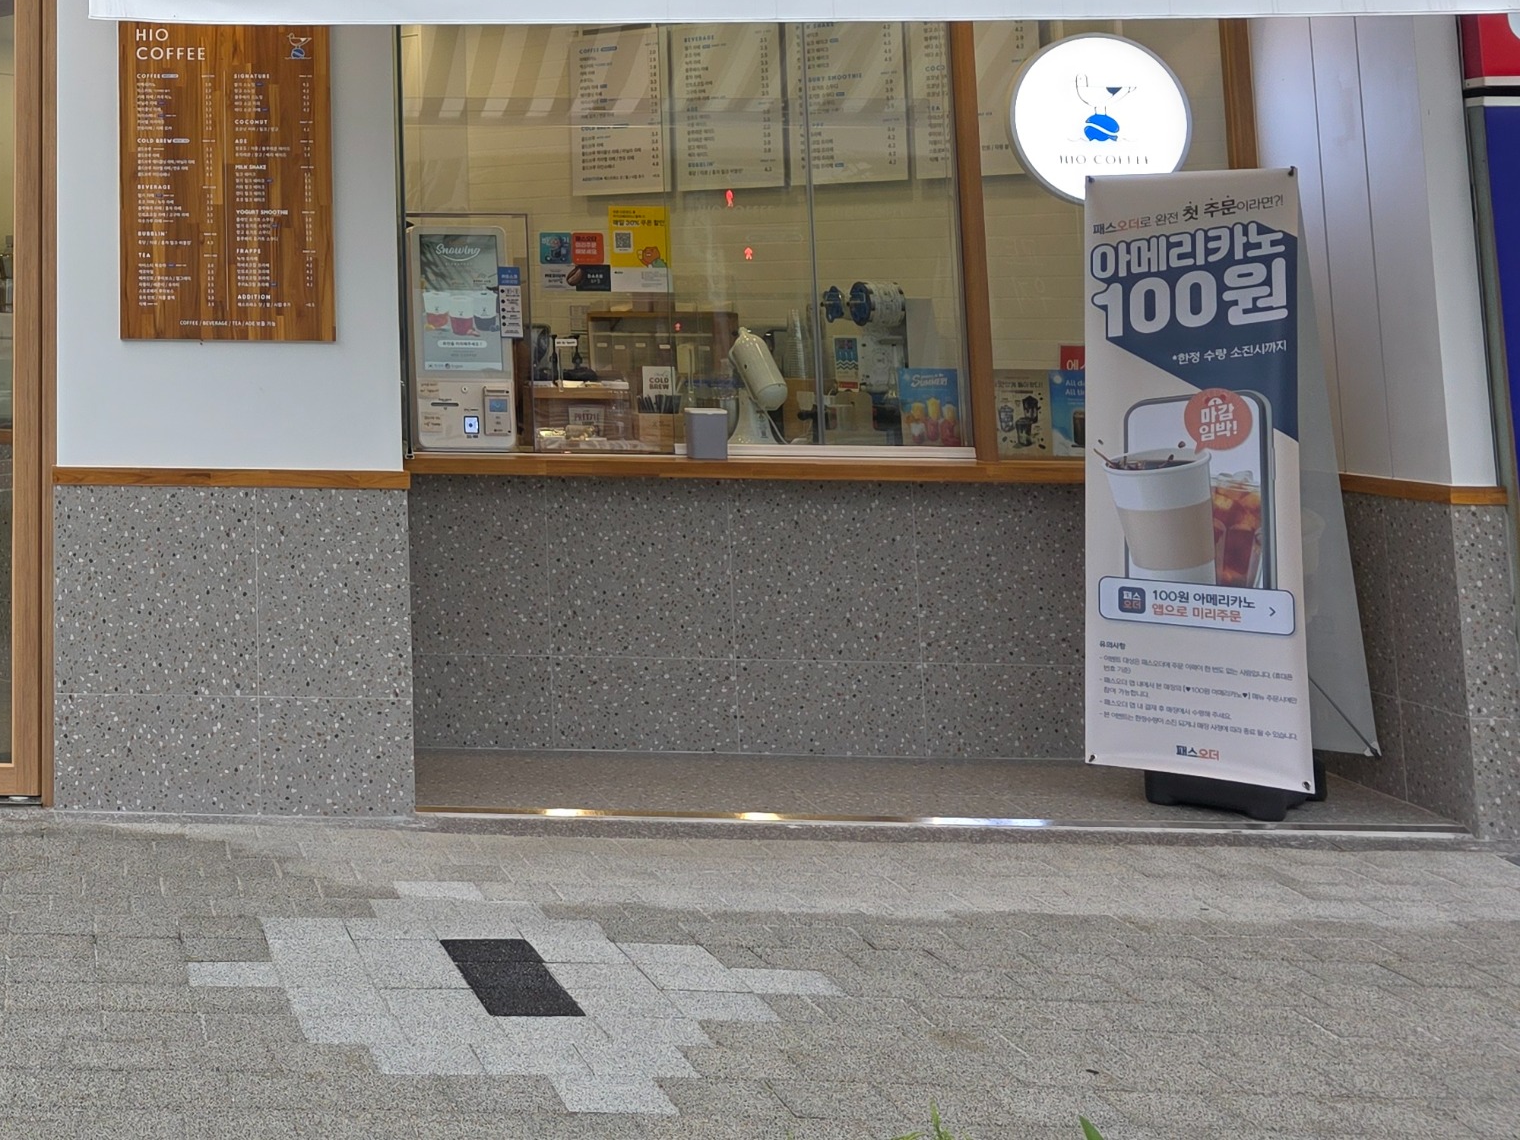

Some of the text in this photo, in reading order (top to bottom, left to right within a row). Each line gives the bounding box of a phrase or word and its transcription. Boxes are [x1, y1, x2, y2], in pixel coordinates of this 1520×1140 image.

[135, 28, 169, 42] HIO
[136, 46, 206, 61] COFFEE
[1092, 216, 1152, 235] 패스오더로
[1154, 212, 1179, 227] 완전
[1182, 201, 1199, 222] 첫
[1091, 220, 1286, 279] 아메리카노
[1092, 256, 1289, 338] 100원
[1203, 347, 1227, 362] 수량
[1230, 339, 1288, 358] 소진시까지
[1200, 403, 1235, 424] 마감
[1199, 420, 1238, 442] 임박!
[1152, 589, 1257, 610] 100원 아메리카노
[1151, 603, 1242, 623] 앱으로 미리주문
[1175, 744, 1220, 761] 패스오더
